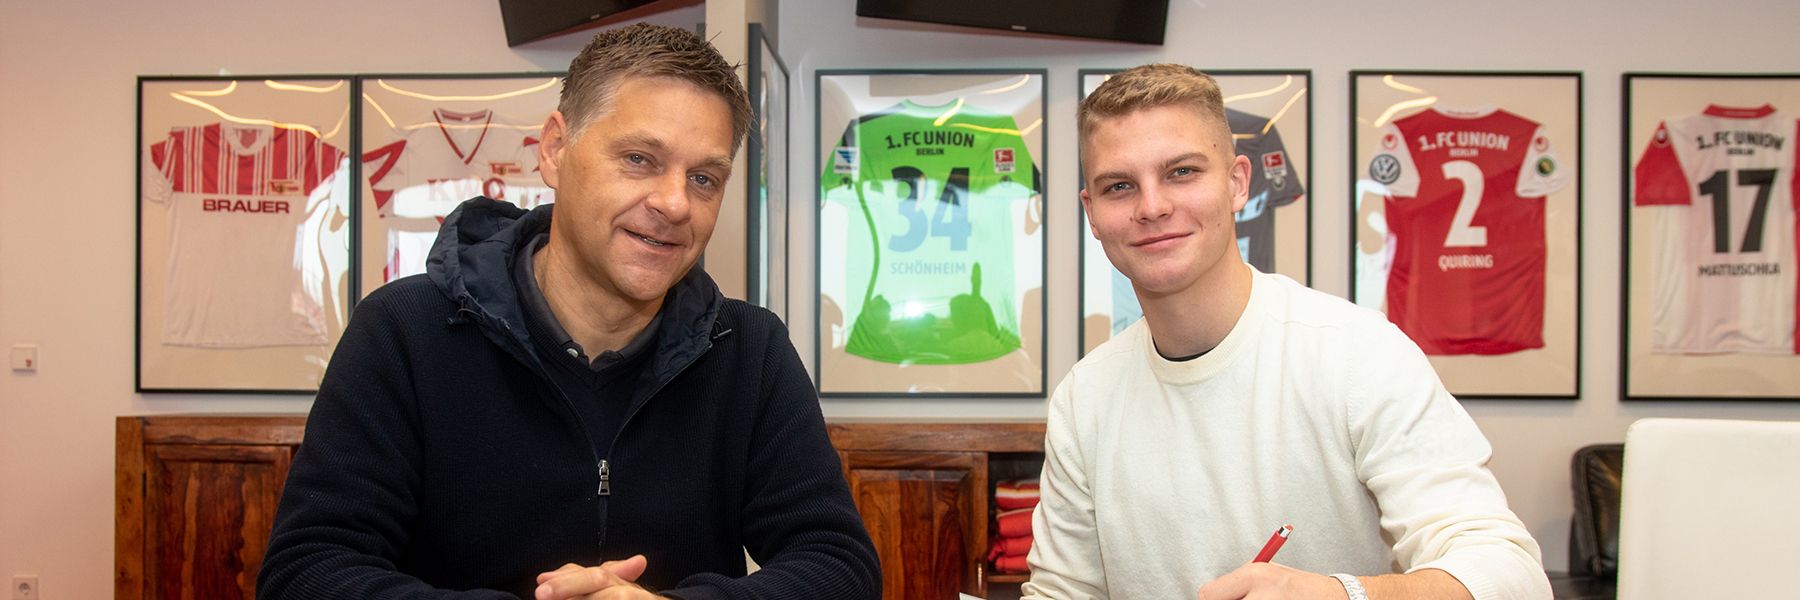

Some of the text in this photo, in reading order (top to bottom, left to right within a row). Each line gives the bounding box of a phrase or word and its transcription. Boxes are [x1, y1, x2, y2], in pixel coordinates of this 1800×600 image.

[886, 130, 975, 149] 1. FC UNION
[1418, 131, 1510, 151] 1. FC UNION
[1714, 131, 1731, 146] FC
[1733, 131, 1785, 151] UNION
[203, 199, 290, 214] BRAUER
[888, 166, 972, 252] 34
[1441, 160, 1487, 247] 2
[1698, 168, 1778, 253] 17
[890, 260, 966, 275] SCHÖNHEIM
[1438, 255, 1494, 271] QUIRING
